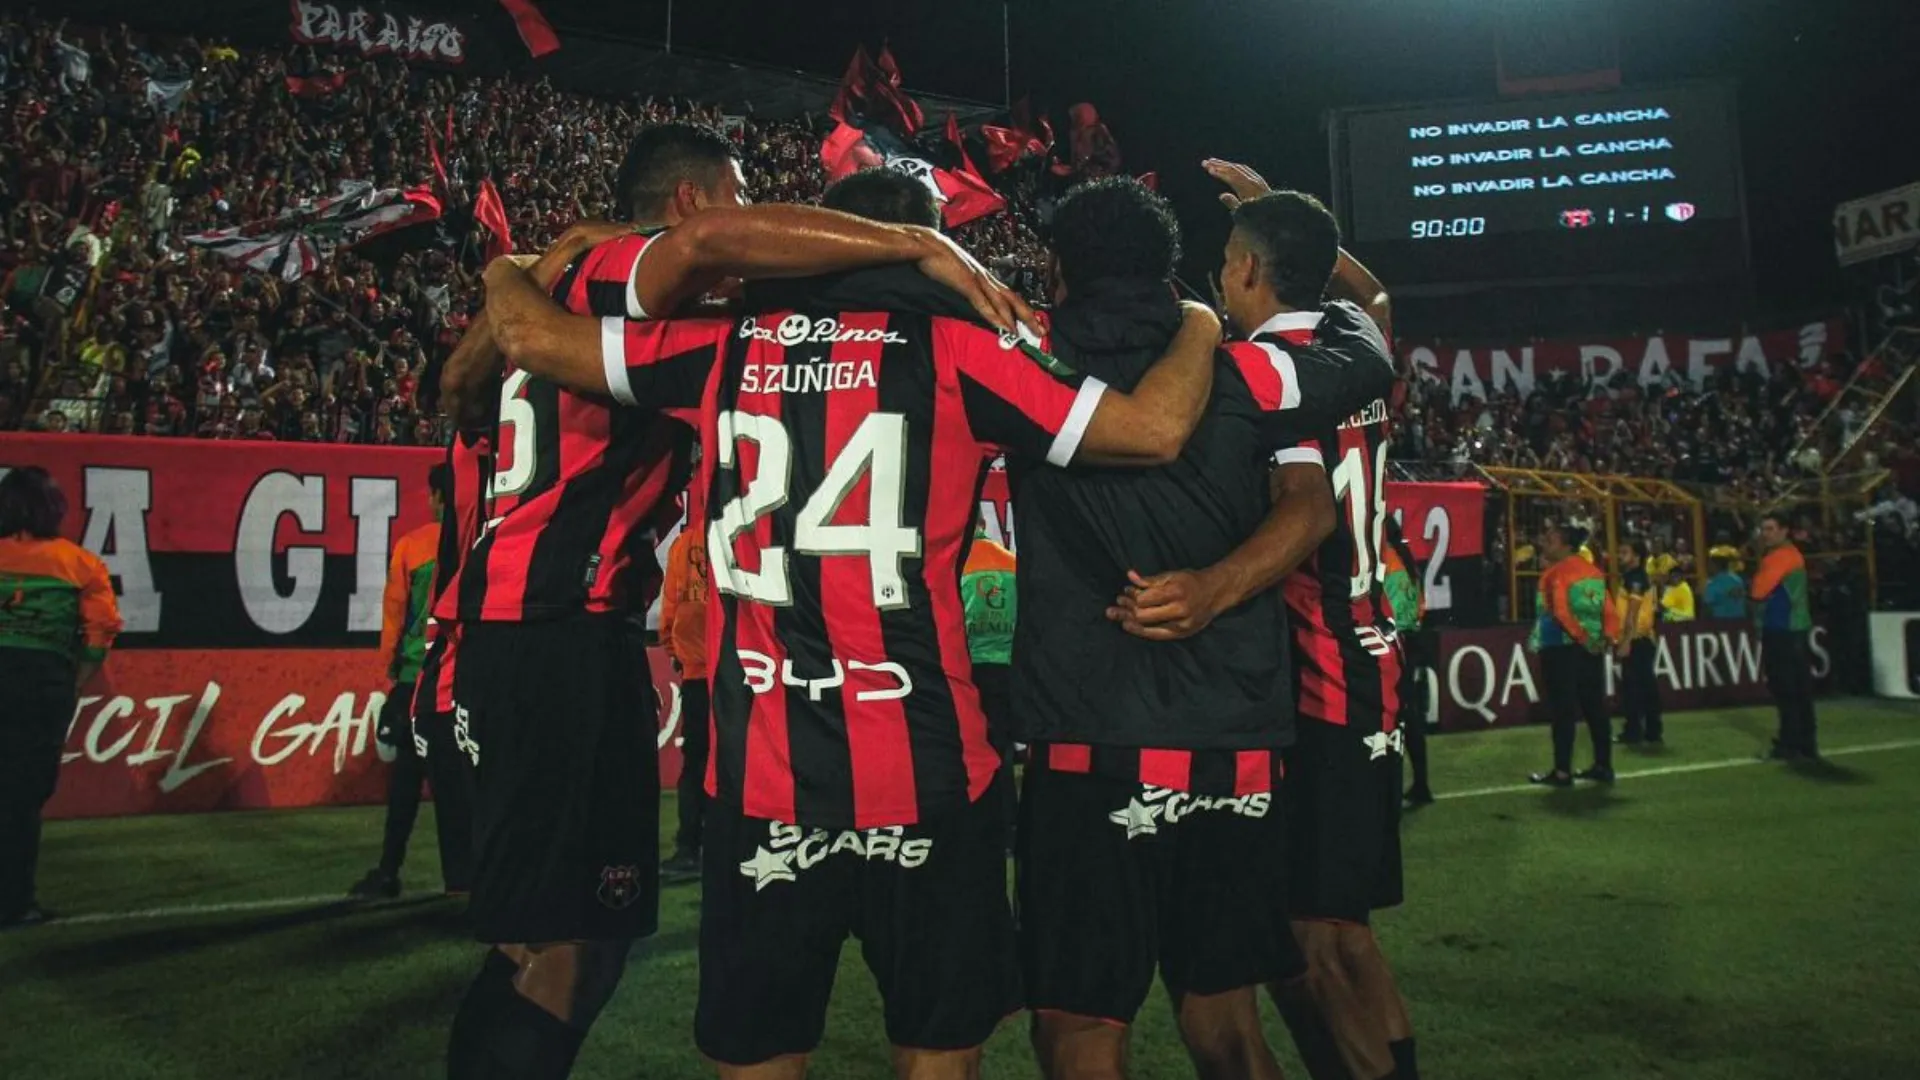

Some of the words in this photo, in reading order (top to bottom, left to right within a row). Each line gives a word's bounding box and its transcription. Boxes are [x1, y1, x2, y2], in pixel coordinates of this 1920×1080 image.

[1409, 126, 1442, 139] NO
[1448, 119, 1530, 136] INVADIR
[1537, 116, 1568, 129] LA
[1575, 107, 1670, 125] CANCHA
[1412, 155, 1444, 168] NO
[1450, 148, 1532, 165] INVADIR
[1540, 145, 1571, 158] LA
[1577, 137, 1673, 155] CANCHA
[1413, 184, 1446, 197] NO
[1451, 178, 1535, 194] INVADIR
[1542, 174, 1573, 188] LA
[1580, 168, 1676, 186] CANCHA
[1410, 217, 1486, 239] 90:00
[806, 318, 908, 343] Pinos
[740, 356, 877, 394] S.ZUÑIGA
[1409, 346, 1535, 411] SAN
[707, 409, 922, 613] 24
[736, 649, 913, 702] BYD
[1653, 626, 1830, 691] AIRWS
[796, 829, 933, 870] CARS
